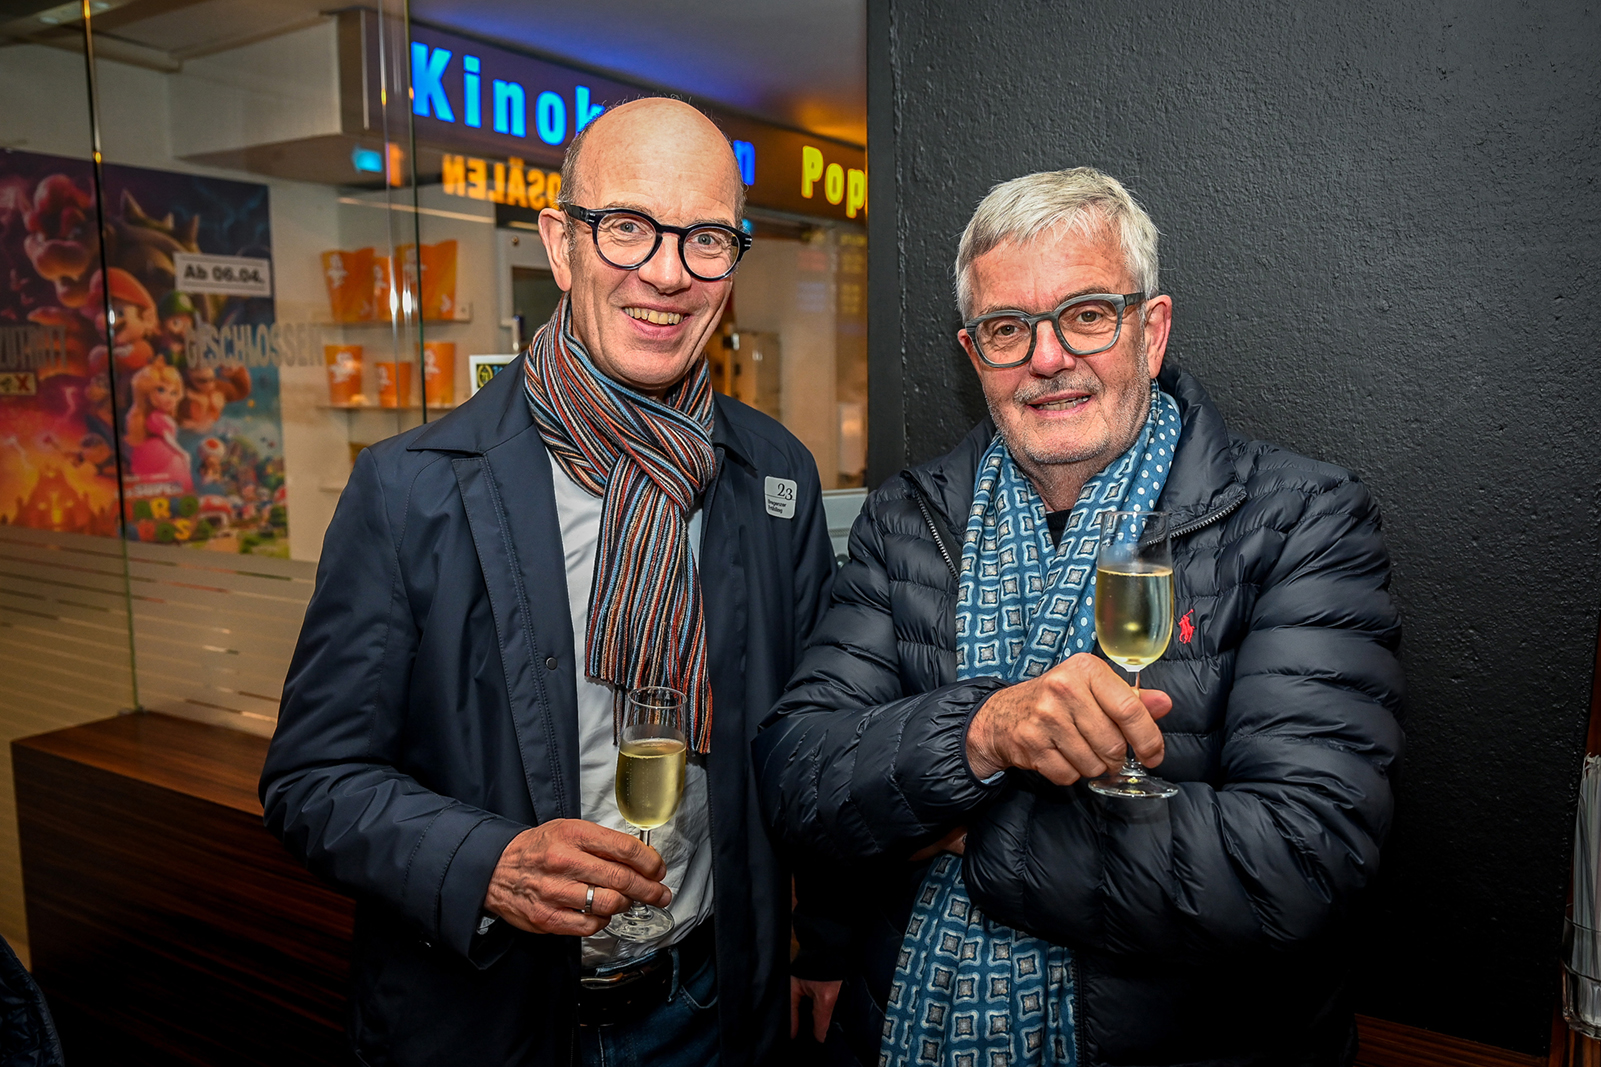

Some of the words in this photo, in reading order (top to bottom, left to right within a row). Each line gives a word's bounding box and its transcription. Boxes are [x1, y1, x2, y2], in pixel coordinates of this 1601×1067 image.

[801, 145, 866, 219] Pop
[184, 264, 207, 281] Ab
[212, 266, 265, 284] 06.04.
[184, 323, 323, 369] GESCHLOSSEN
[777, 483, 793, 501] 23
